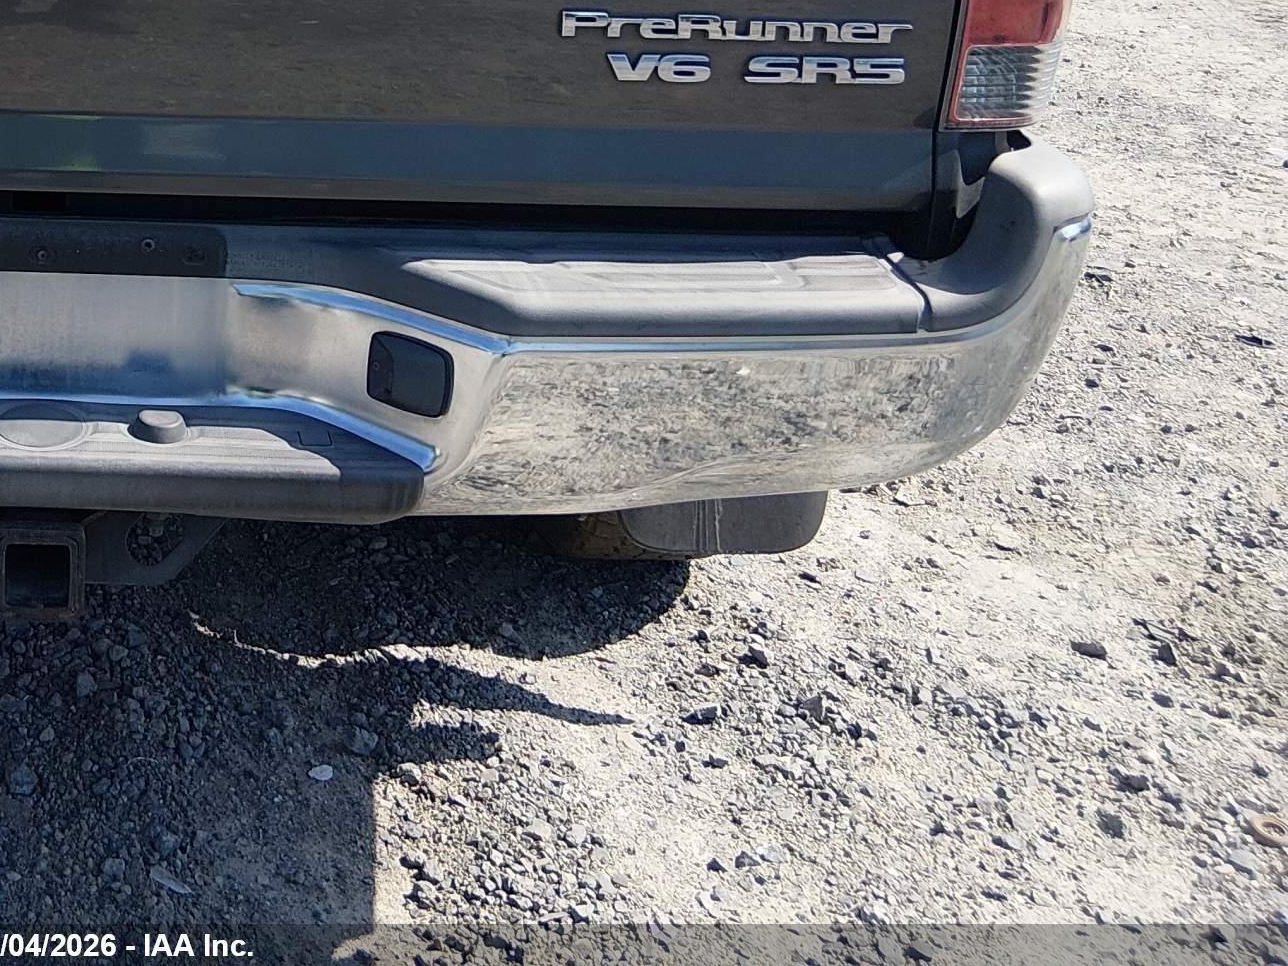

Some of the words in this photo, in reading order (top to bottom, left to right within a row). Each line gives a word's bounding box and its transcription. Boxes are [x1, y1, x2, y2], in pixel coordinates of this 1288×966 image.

[561, 9, 913, 44] PreRunner
[606, 52, 712, 83] V6
[744, 55, 905, 85] SR5
